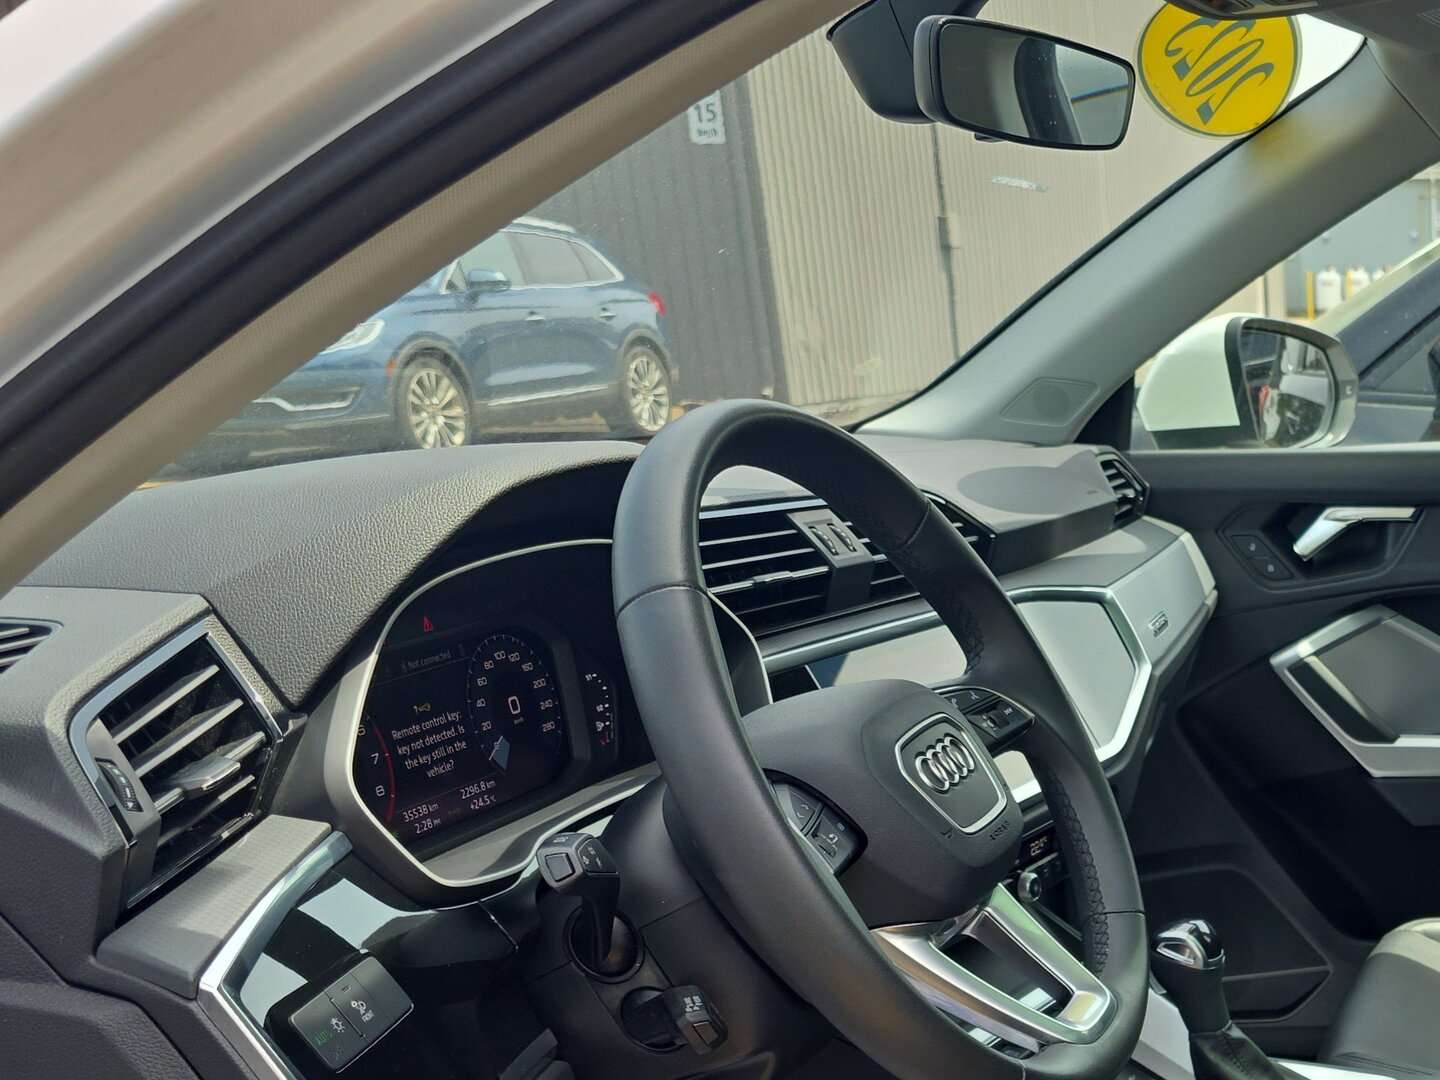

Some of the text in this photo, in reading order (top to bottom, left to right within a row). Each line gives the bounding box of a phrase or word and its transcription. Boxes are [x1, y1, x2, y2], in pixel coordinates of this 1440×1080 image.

[694, 102, 717, 123] 15
[477, 676, 488, 686] 60
[533, 678, 546, 689] 200
[508, 695, 521, 715] 0
[391, 711, 462, 740] Remote control key:
[481, 720, 492, 731] 20
[396, 724, 465, 756] key not detected. Is
[370, 752, 379, 765] 7
[404, 740, 467, 770] the key still in the
[426, 759, 455, 778] vehicle?
[375, 784, 385, 797] 8
[460, 781, 486, 799] 2296.8
[402, 804, 429, 823] 35538
[428, 803, 439, 812] km
[414, 818, 433, 834] 2:28
